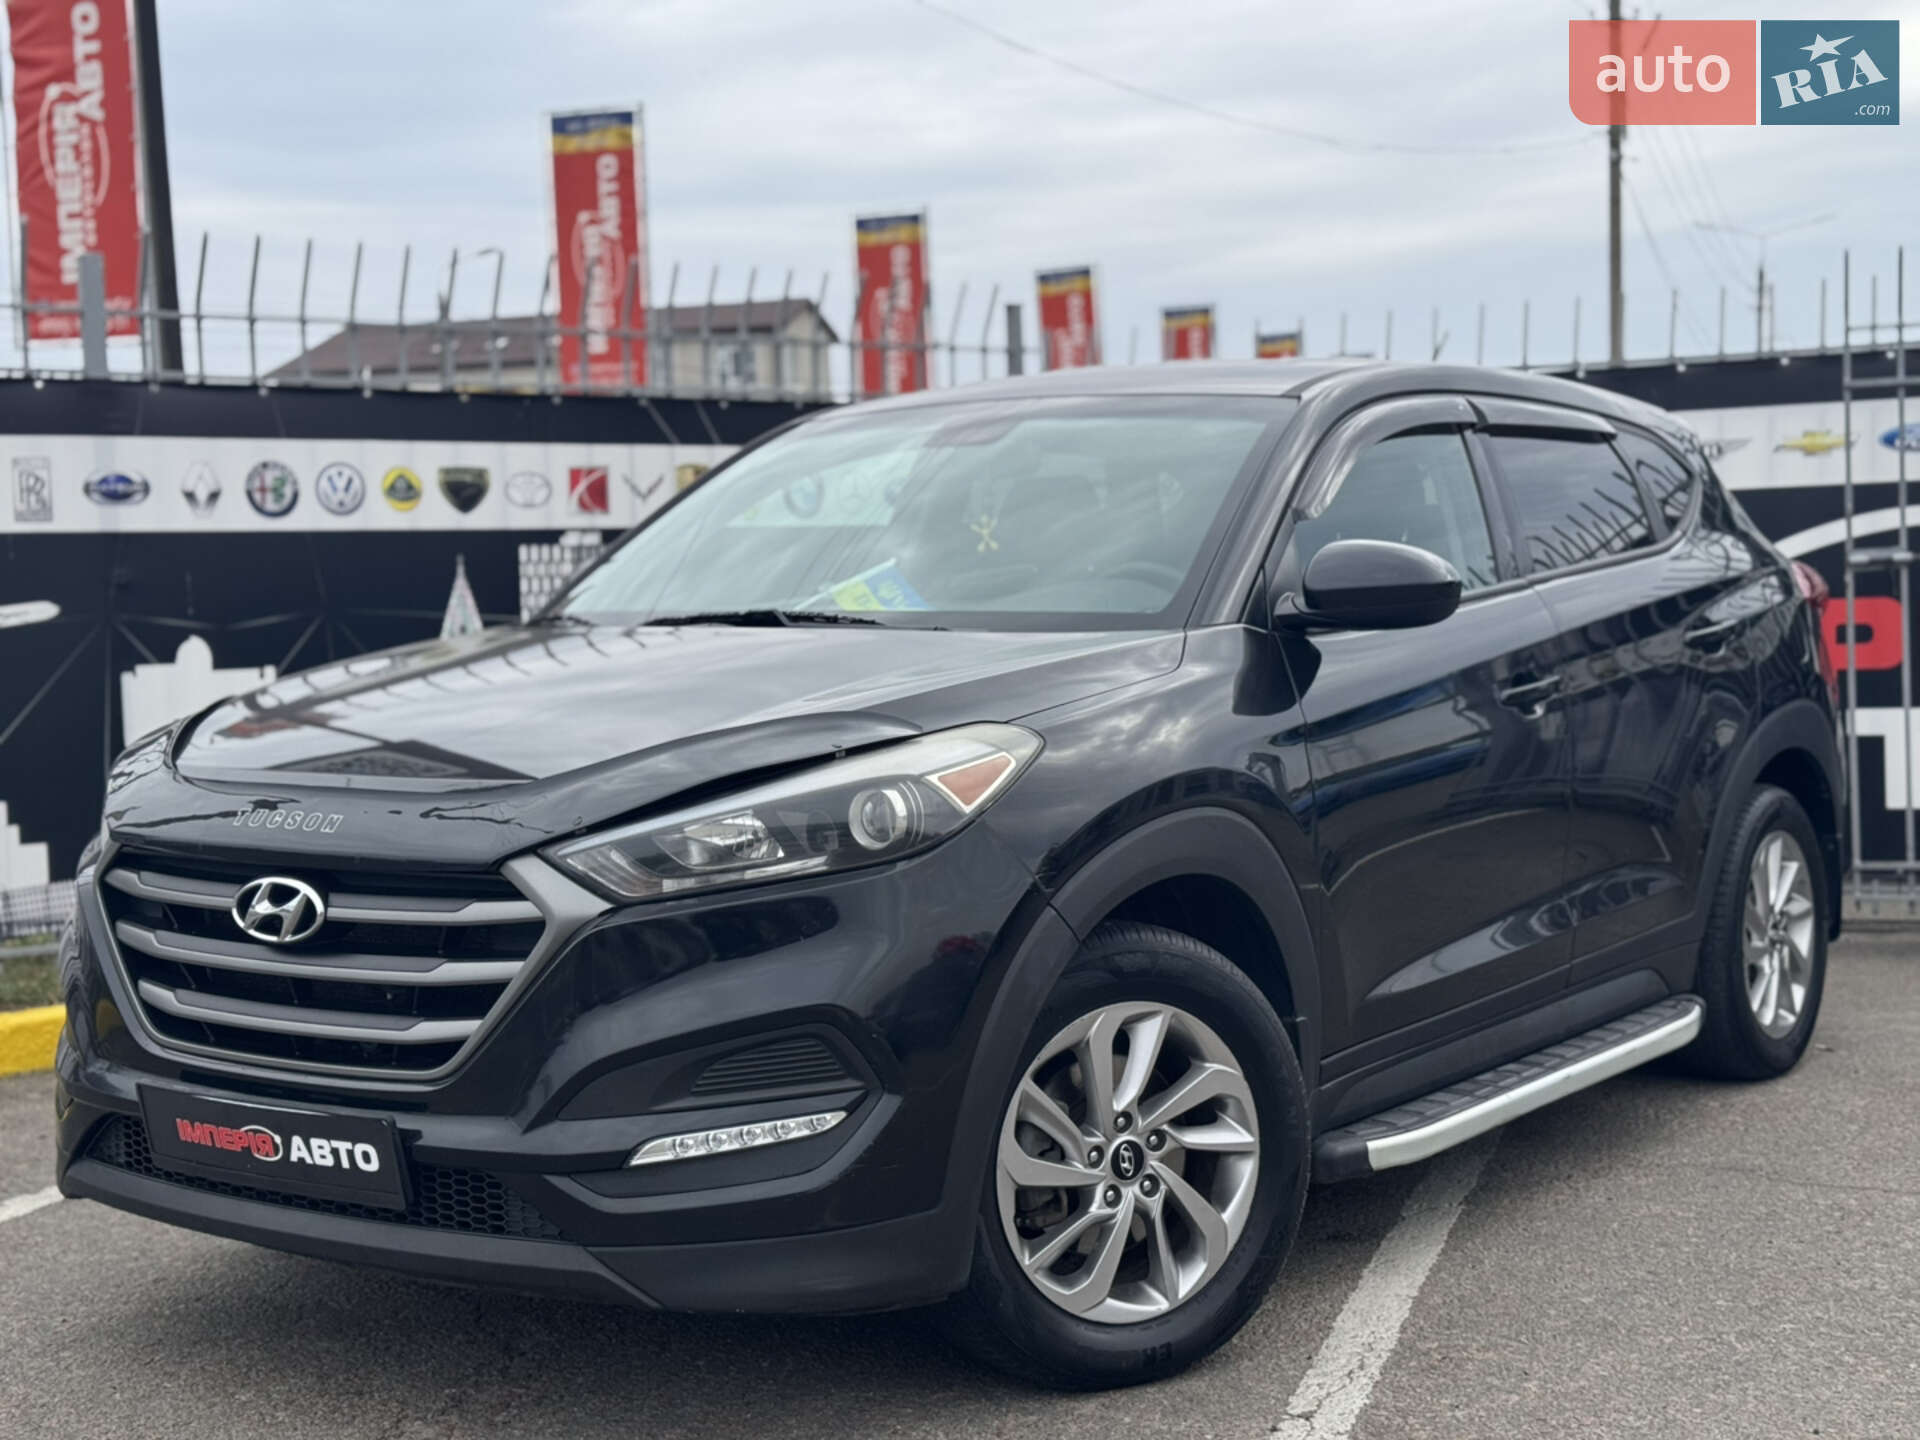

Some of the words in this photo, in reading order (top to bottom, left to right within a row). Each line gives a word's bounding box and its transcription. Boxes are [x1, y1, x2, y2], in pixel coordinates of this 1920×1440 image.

[70, 0, 105, 122] АВТО
[232, 807, 345, 833] TUCSON
[175, 1117, 276, 1158] ІМПЕРІЯ
[289, 1134, 381, 1173] АВТО
